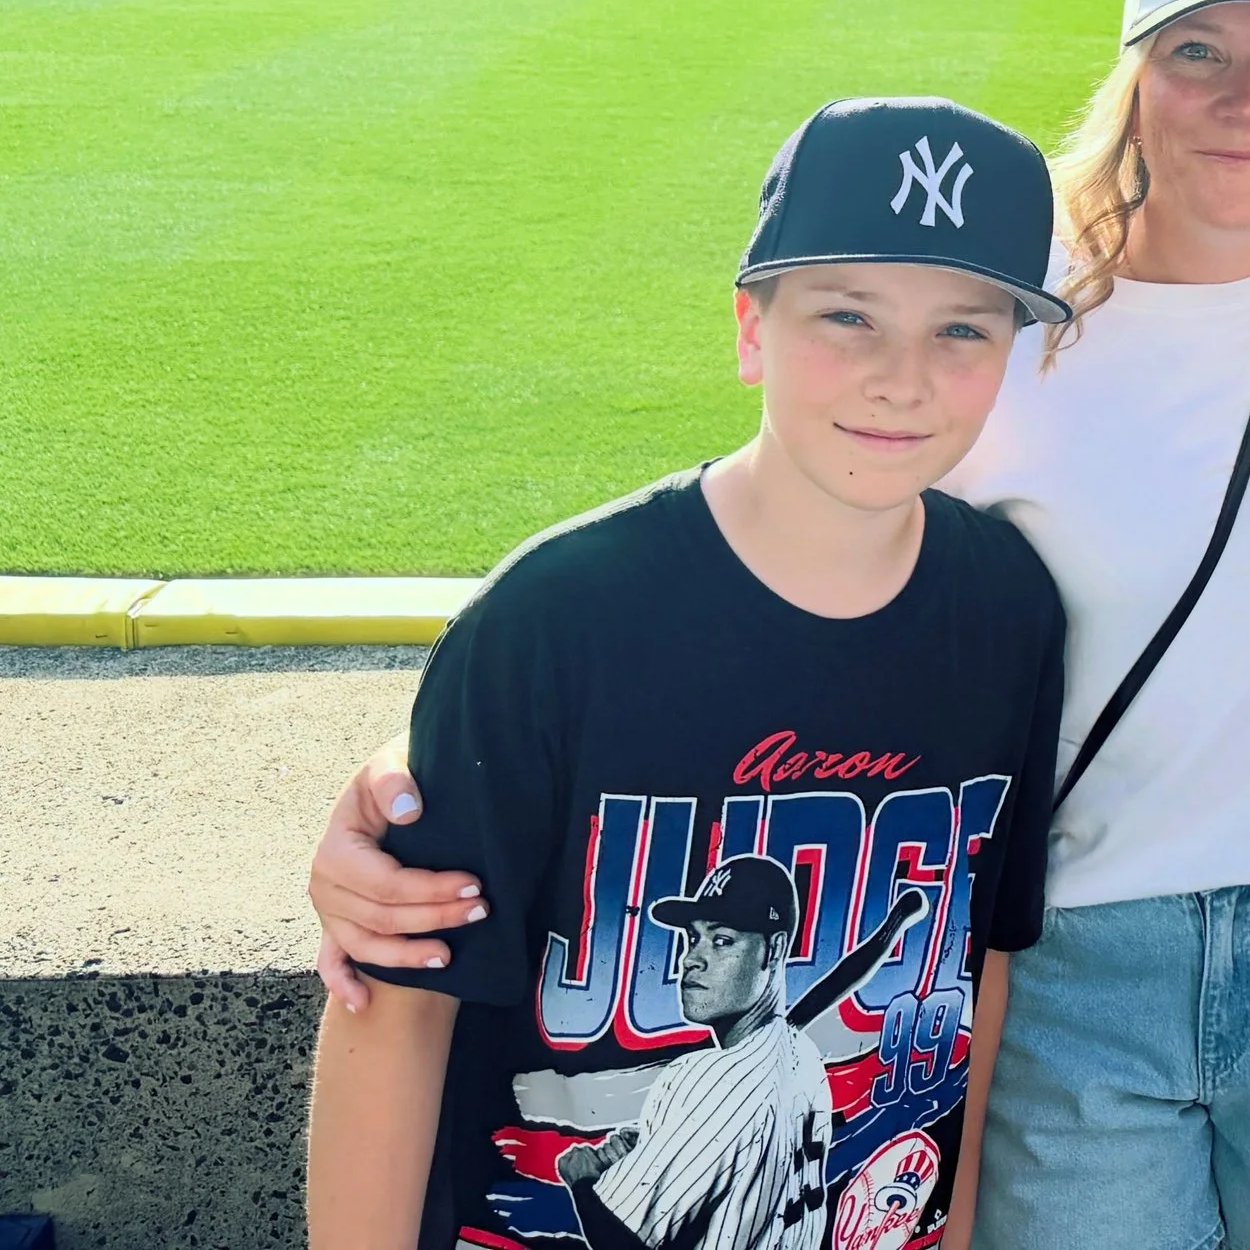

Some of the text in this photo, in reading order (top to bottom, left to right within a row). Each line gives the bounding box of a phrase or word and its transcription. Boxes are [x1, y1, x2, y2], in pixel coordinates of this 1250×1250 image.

[890, 135, 974, 229] NY
[733, 730, 921, 792] Aaron
[870, 987, 965, 1108] 99
